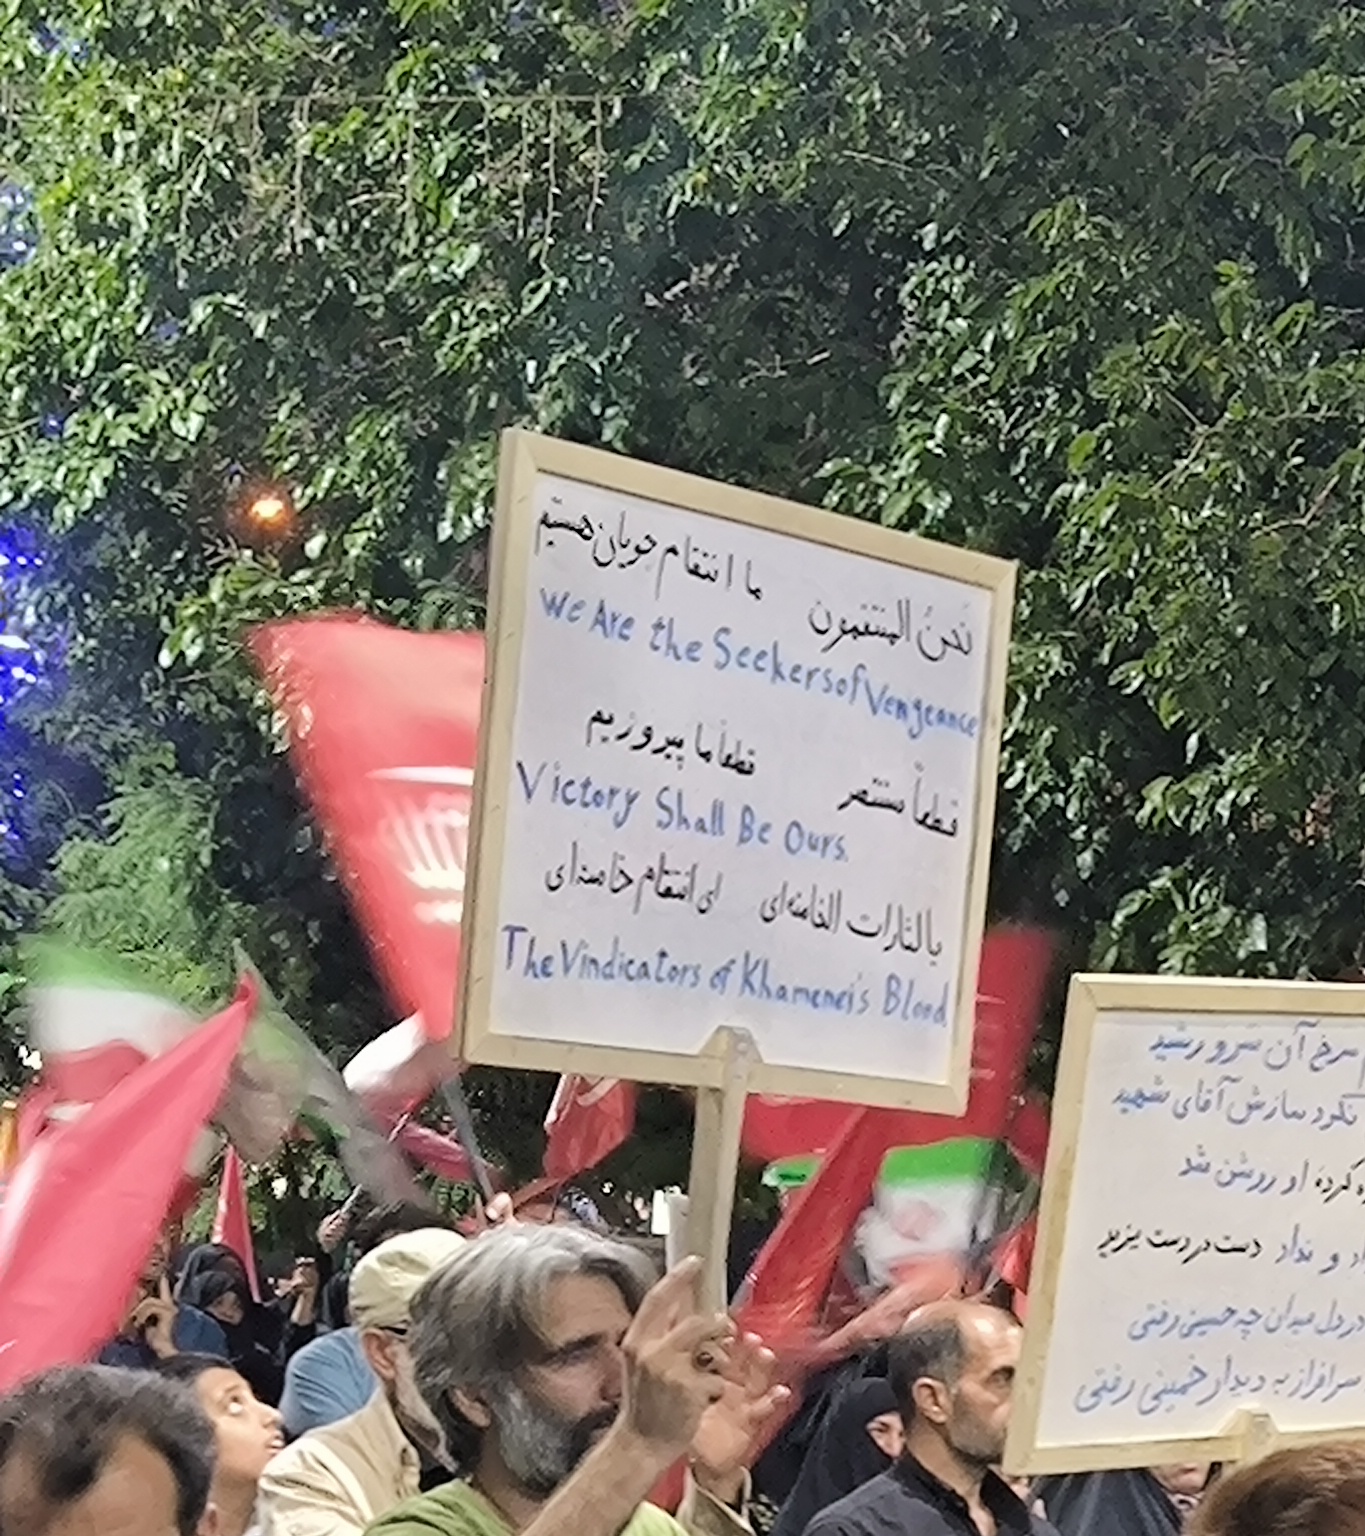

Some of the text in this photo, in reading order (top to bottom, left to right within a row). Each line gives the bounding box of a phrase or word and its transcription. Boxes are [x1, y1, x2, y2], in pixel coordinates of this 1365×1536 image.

[588, 599, 636, 643] Are
[649, 616, 703, 663] the
[516, 759, 641, 829] Victory
[655, 786, 726, 837] Shall
[736, 804, 773, 848] Be
[501, 924, 554, 979] The
[559, 935, 701, 989] Vindicators
